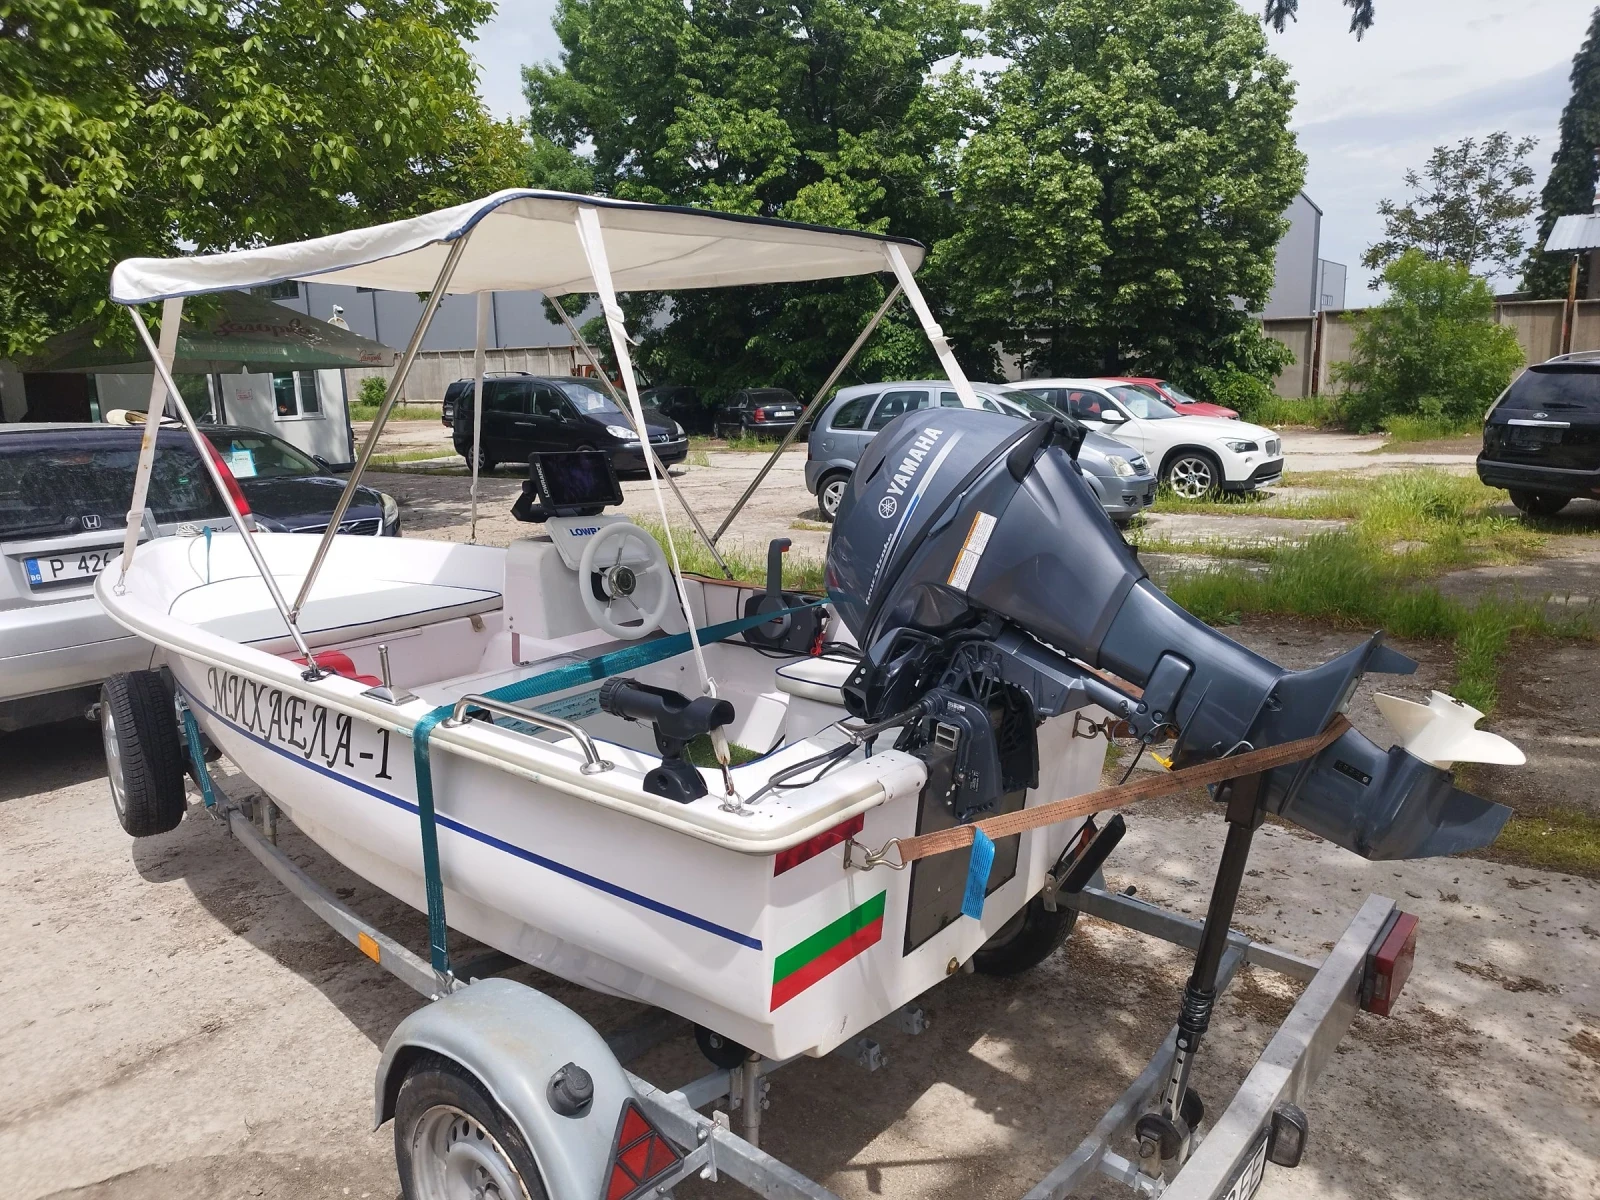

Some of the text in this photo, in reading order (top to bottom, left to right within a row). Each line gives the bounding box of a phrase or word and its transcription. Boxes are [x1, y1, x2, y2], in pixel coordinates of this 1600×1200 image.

[535, 462, 550, 498] LOWRANCE
[887, 427, 943, 496] YAMAHA
[50, 550, 124, 578] P 426
[208, 667, 392, 780] МИХАЕЛА-1
